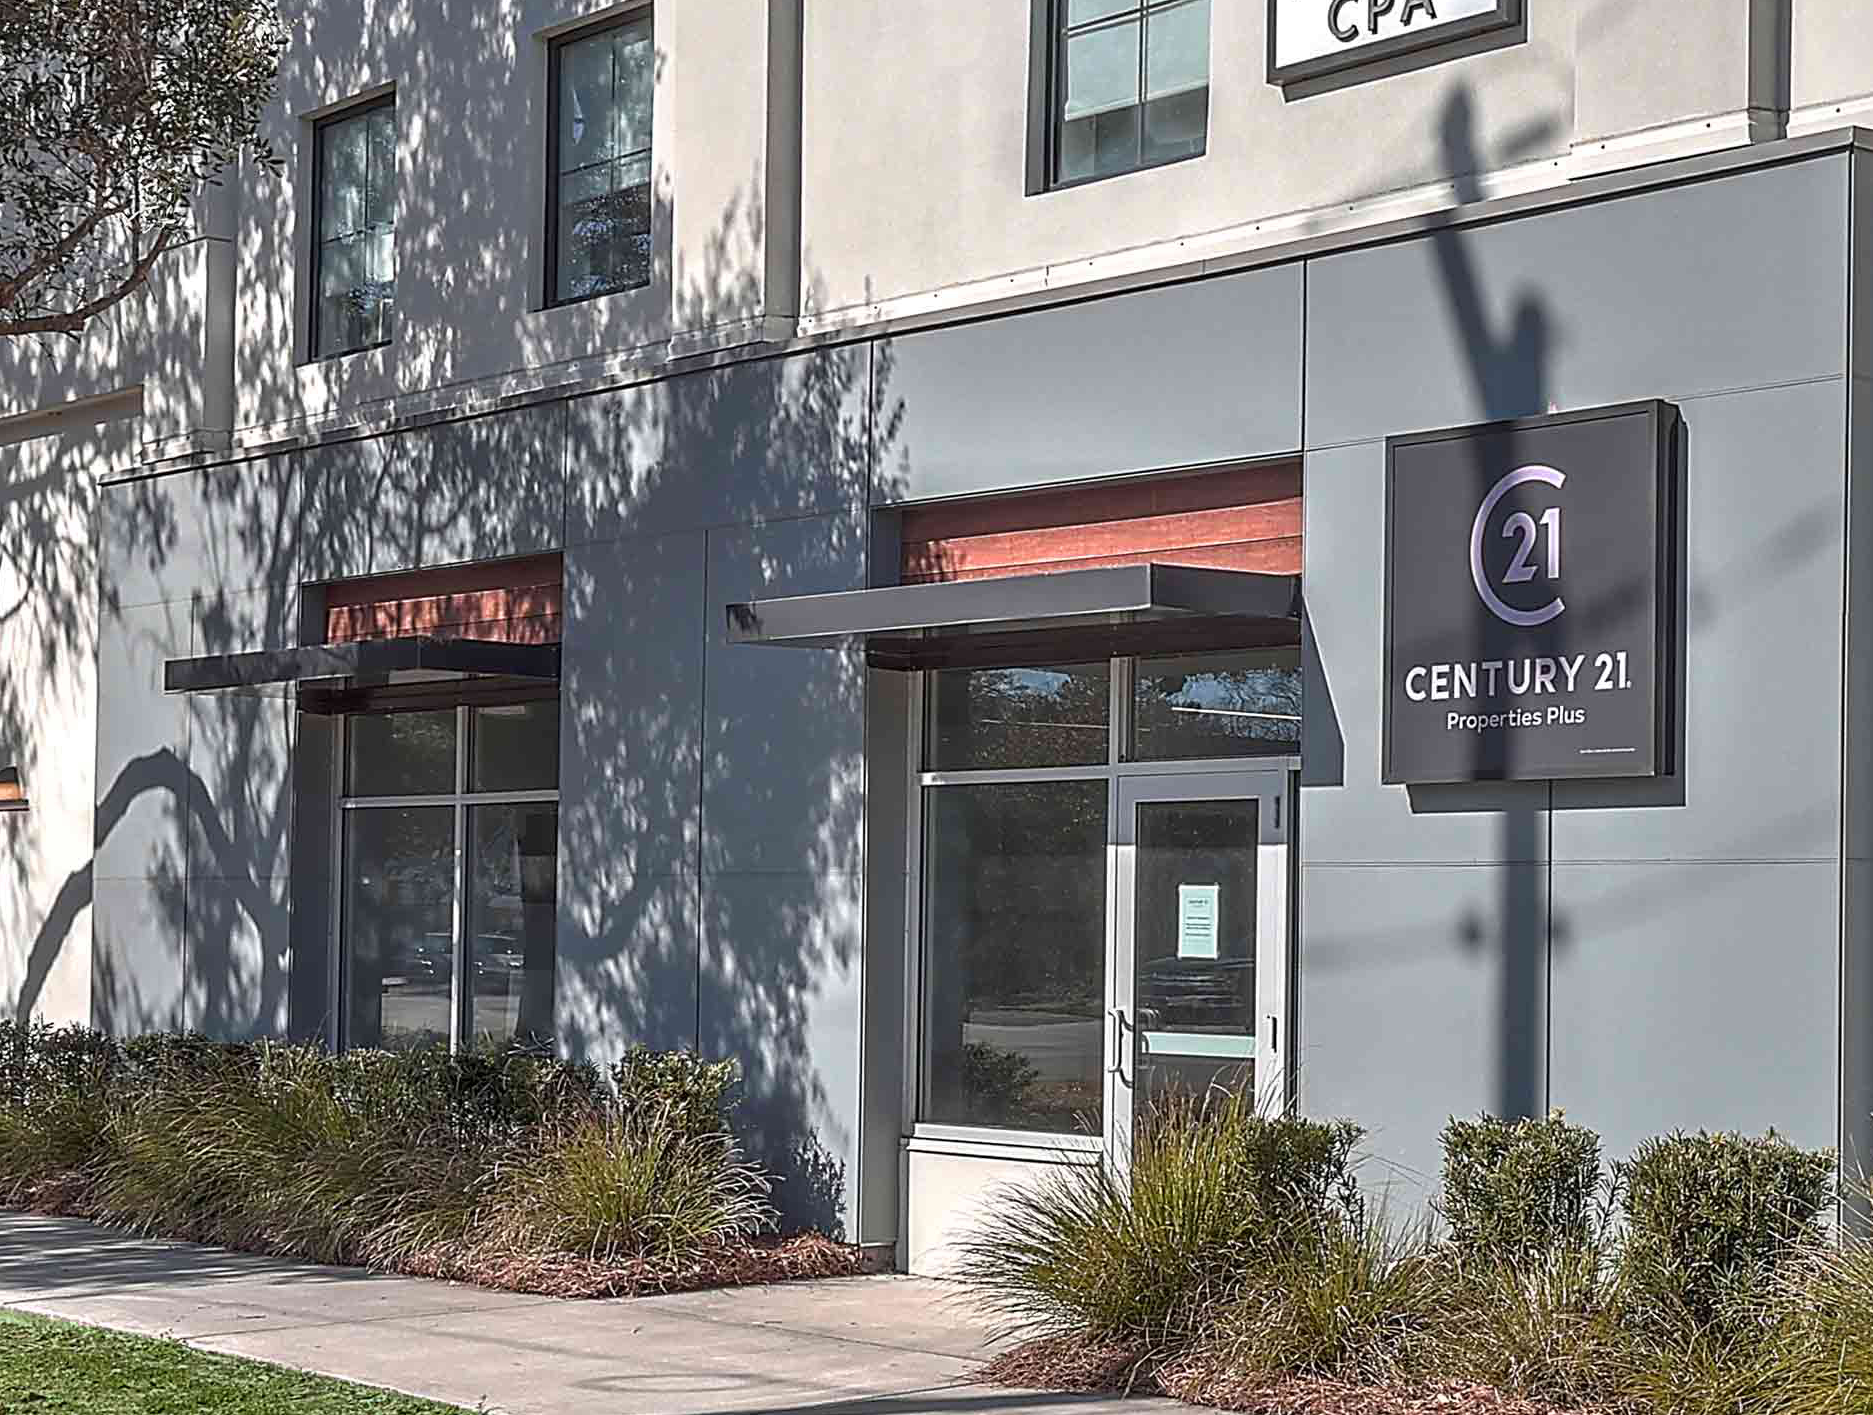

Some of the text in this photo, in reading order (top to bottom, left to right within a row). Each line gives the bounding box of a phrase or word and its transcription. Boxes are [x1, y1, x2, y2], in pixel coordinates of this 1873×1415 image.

[1404, 653, 1586, 702] CENTURY
[1446, 705, 1586, 733] Properties Plus
